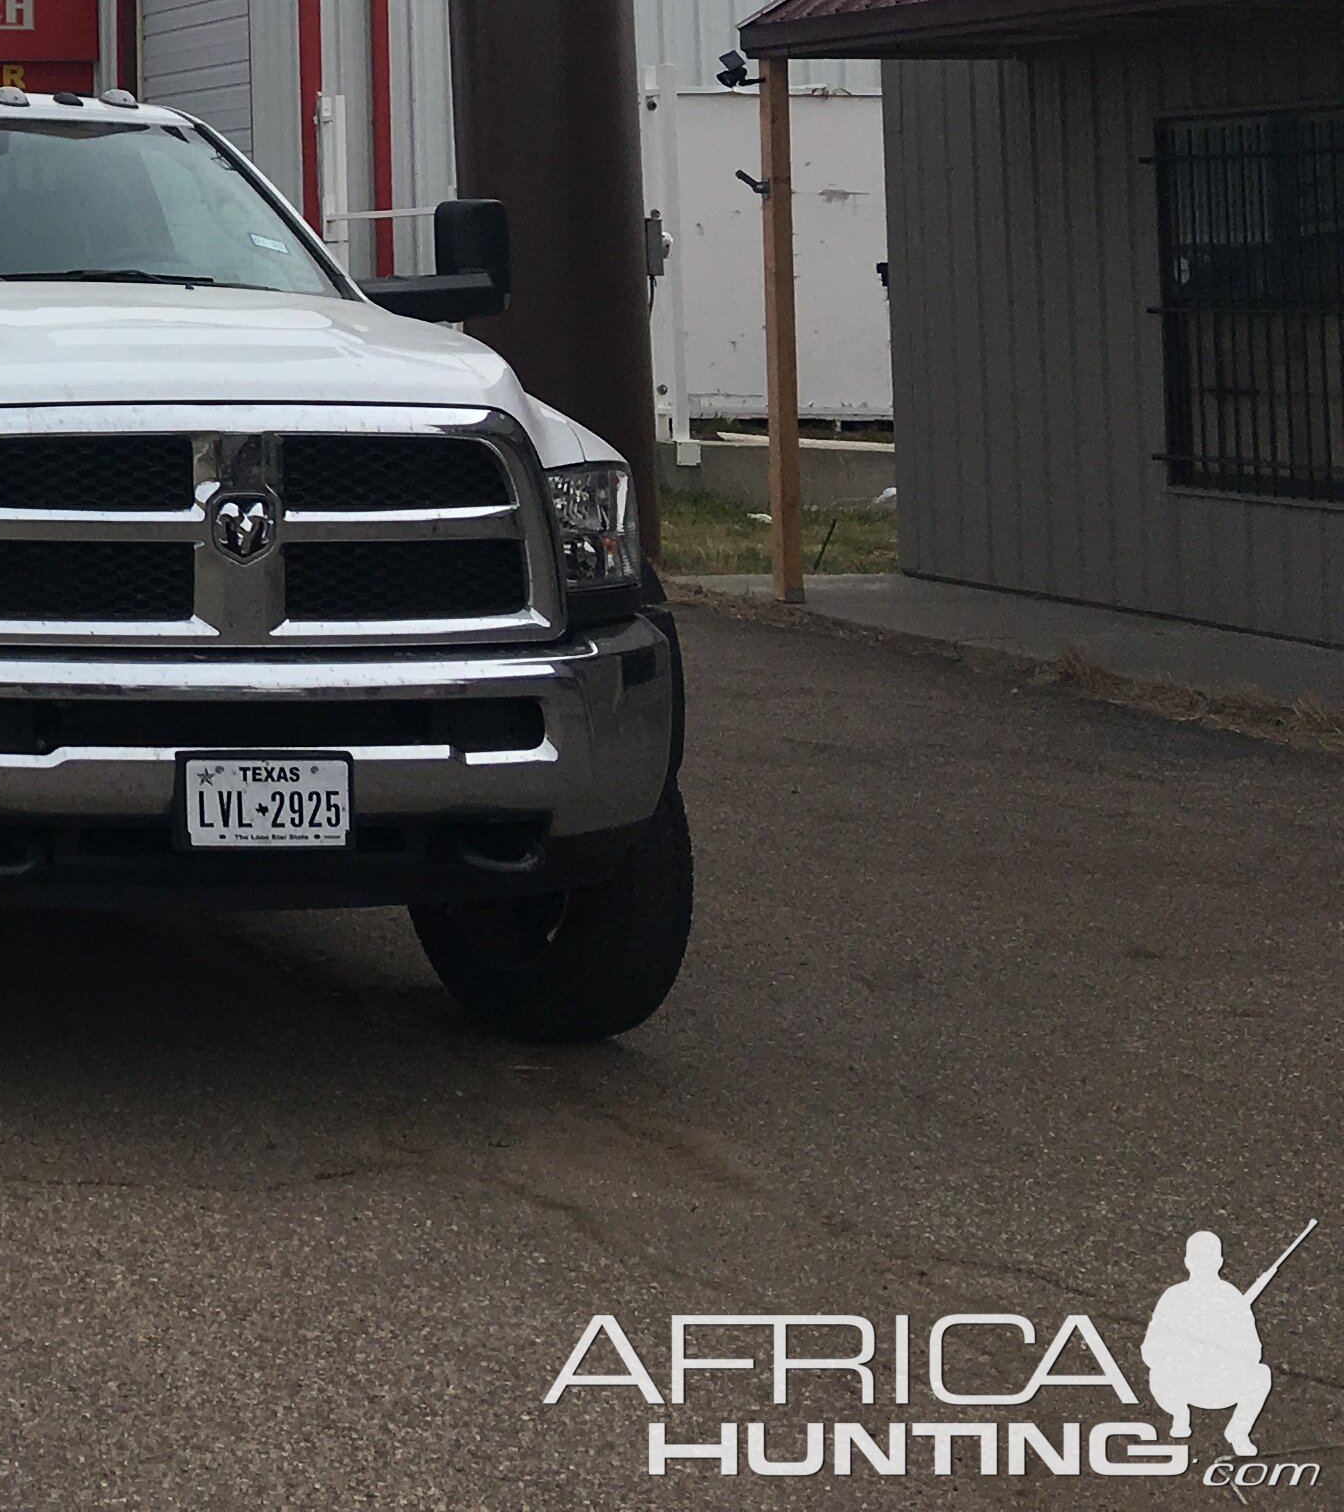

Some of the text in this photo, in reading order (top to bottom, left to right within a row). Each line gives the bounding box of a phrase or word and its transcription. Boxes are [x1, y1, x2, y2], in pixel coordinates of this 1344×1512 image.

[238, 766, 301, 783] TEXAS
[198, 790, 341, 828] LVL 2925
